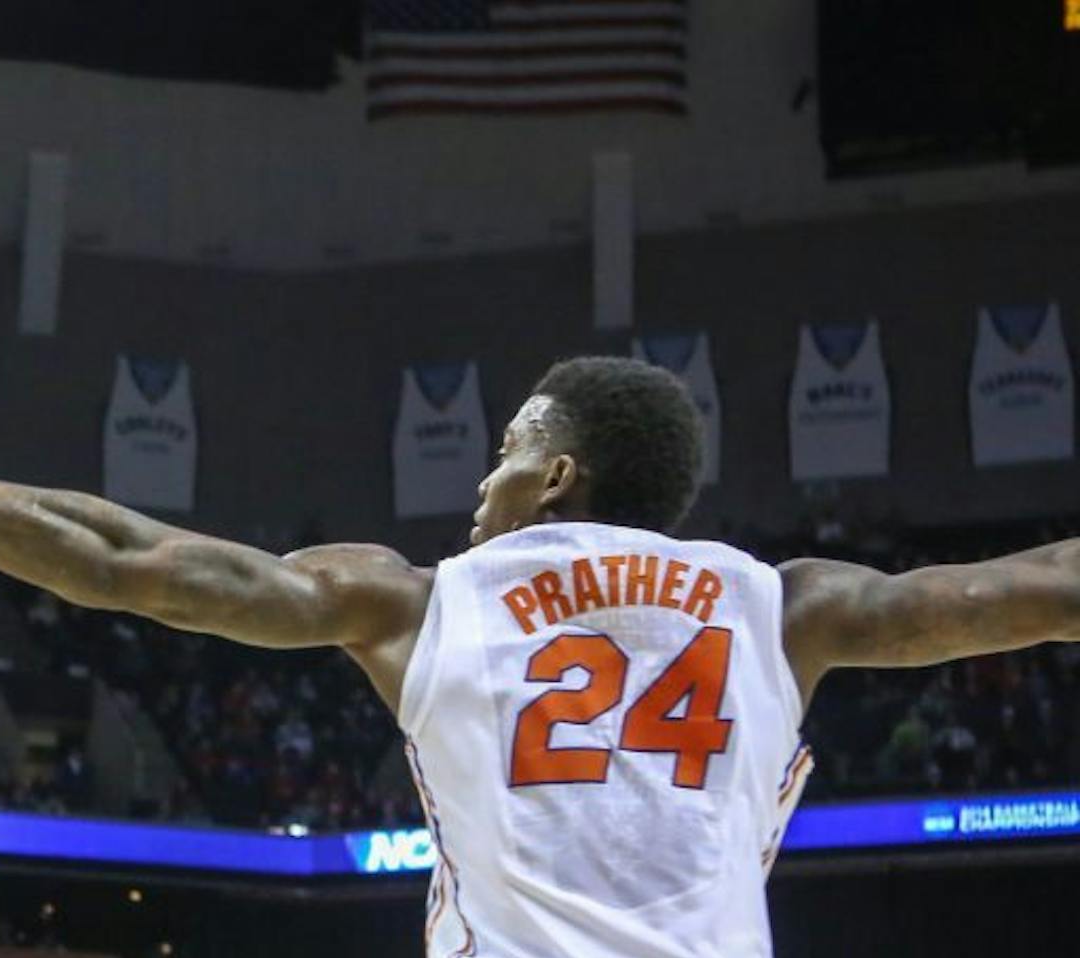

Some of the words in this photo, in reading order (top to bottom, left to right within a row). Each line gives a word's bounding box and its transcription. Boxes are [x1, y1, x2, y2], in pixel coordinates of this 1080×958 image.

[502, 554, 723, 635] PRATHER
[507, 626, 735, 791] 24
[366, 830, 438, 872] NC
